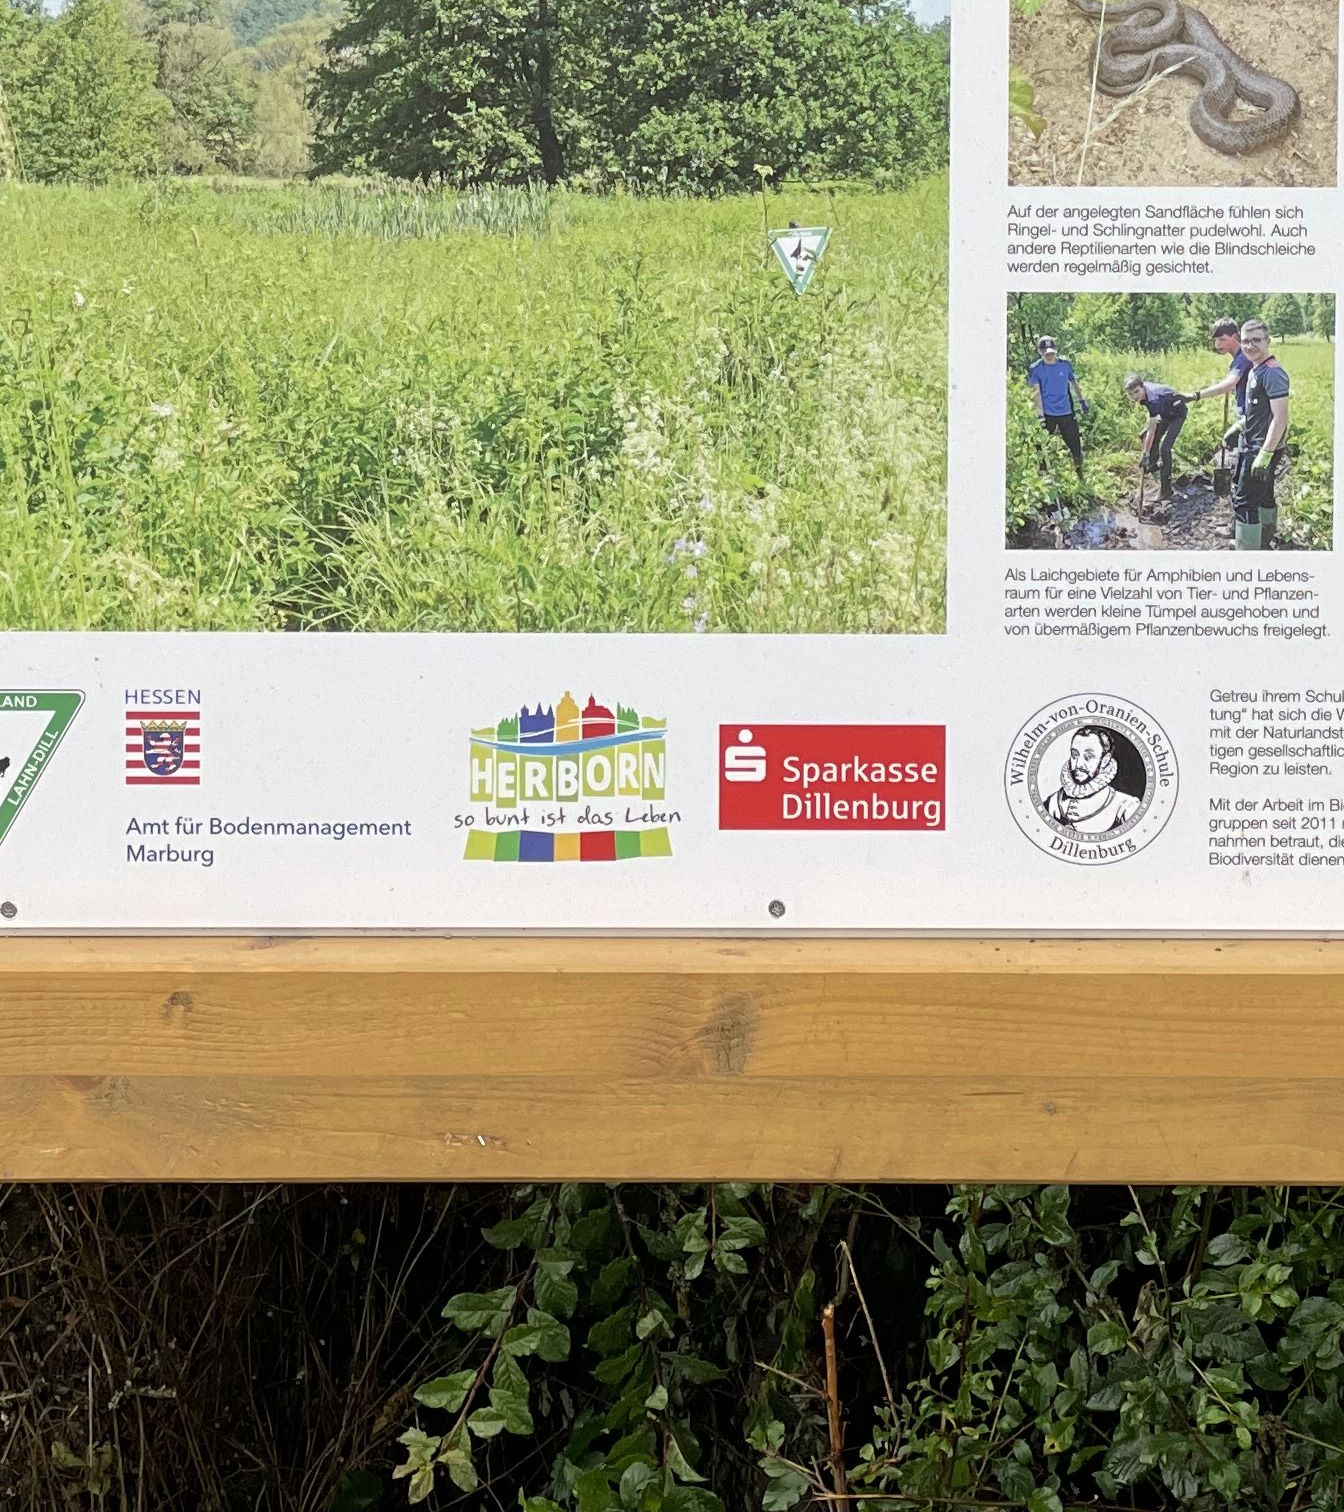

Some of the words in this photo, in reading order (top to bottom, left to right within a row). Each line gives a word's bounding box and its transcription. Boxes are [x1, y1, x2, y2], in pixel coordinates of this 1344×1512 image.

[1006, 204, 1033, 219] Auf
[1035, 204, 1060, 219] der
[1062, 204, 1141, 222] angelegten
[1144, 204, 1225, 219] Sandfläche
[1227, 204, 1271, 220] fühlen
[1274, 205, 1304, 220] sich
[1007, 222, 1057, 240] Ringel-
[1061, 223, 1089, 237] und
[1092, 222, 1186, 241] Schlingnatter
[1189, 223, 1266, 241] pudelwohl.
[1270, 223, 1308, 238] Auch
[1007, 240, 1057, 256] andere
[1060, 240, 1157, 258] Reptilienarten
[1160, 241, 1186, 256] wie
[1188, 241, 1211, 256] die
[1214, 241, 1316, 256] Blindschleiche
[1006, 259, 1060, 274] werden
[1063, 259, 1142, 277] regelmäßig
[1145, 259, 1214, 277] gesichtet.
[1003, 567, 1027, 582] Als
[1030, 567, 1121, 585] Laichgebiete
[1122, 567, 1144, 583] für
[1145, 567, 1222, 585] Amphibien
[1225, 568, 1254, 583] und
[1257, 568, 1316, 583] Lebens-
[1003, 624, 1031, 636] von
[1034, 622, 1132, 640] übermäßigem
[1135, 622, 1259, 637] Pflanzenbewuchs
[1262, 622, 1331, 641] freigelegt.
[124, 688, 201, 705] HESSEN
[1251, 707, 1275, 722] hat
[1277, 707, 1307, 722] sich
[1310, 707, 1333, 722] die
[1010, 698, 1176, 788] Wilhelm-von-Oranien-Schule
[7, 728, 61, 807] LAHN-DILL
[471, 751, 666, 800] HERBORN
[782, 755, 939, 789] Sparkasse
[453, 814, 475, 831] so
[484, 802, 530, 827] bunt
[541, 806, 567, 828] ist
[576, 804, 614, 827] das
[624, 803, 682, 831] Leben
[782, 792, 942, 827] Dillenburg
[125, 816, 170, 836] Amt
[174, 815, 204, 836] für
[209, 815, 412, 841] Bodenmanagement
[126, 842, 214, 868] Marburg
[1048, 836, 1138, 861] Dillenburg
[1208, 851, 1295, 867] Biodiversität
